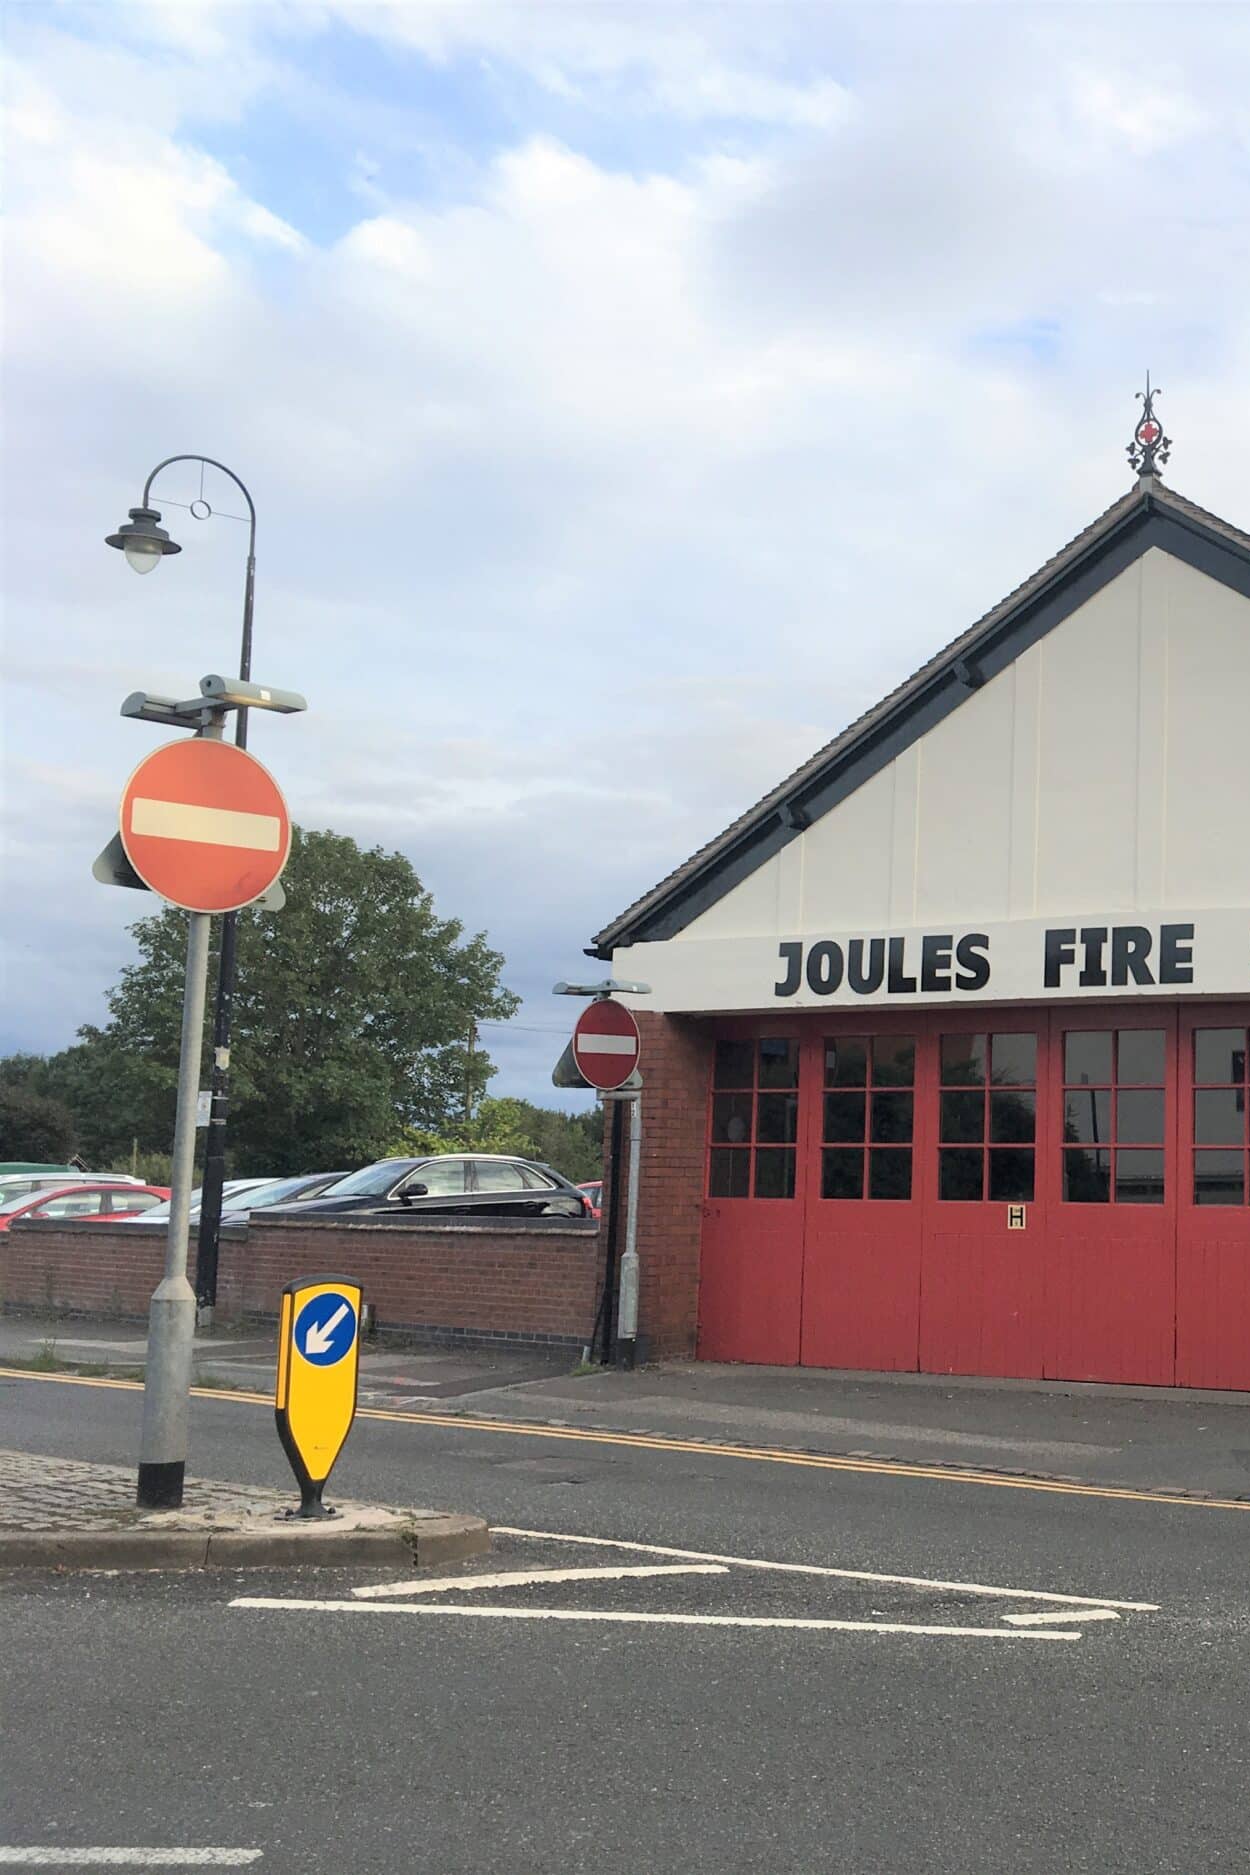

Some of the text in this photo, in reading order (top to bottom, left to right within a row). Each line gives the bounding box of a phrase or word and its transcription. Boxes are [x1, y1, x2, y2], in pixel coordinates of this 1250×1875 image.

[775, 933, 991, 997] JOULES
[1044, 923, 1195, 988] FIRE
[1009, 1206, 1024, 1228] H
